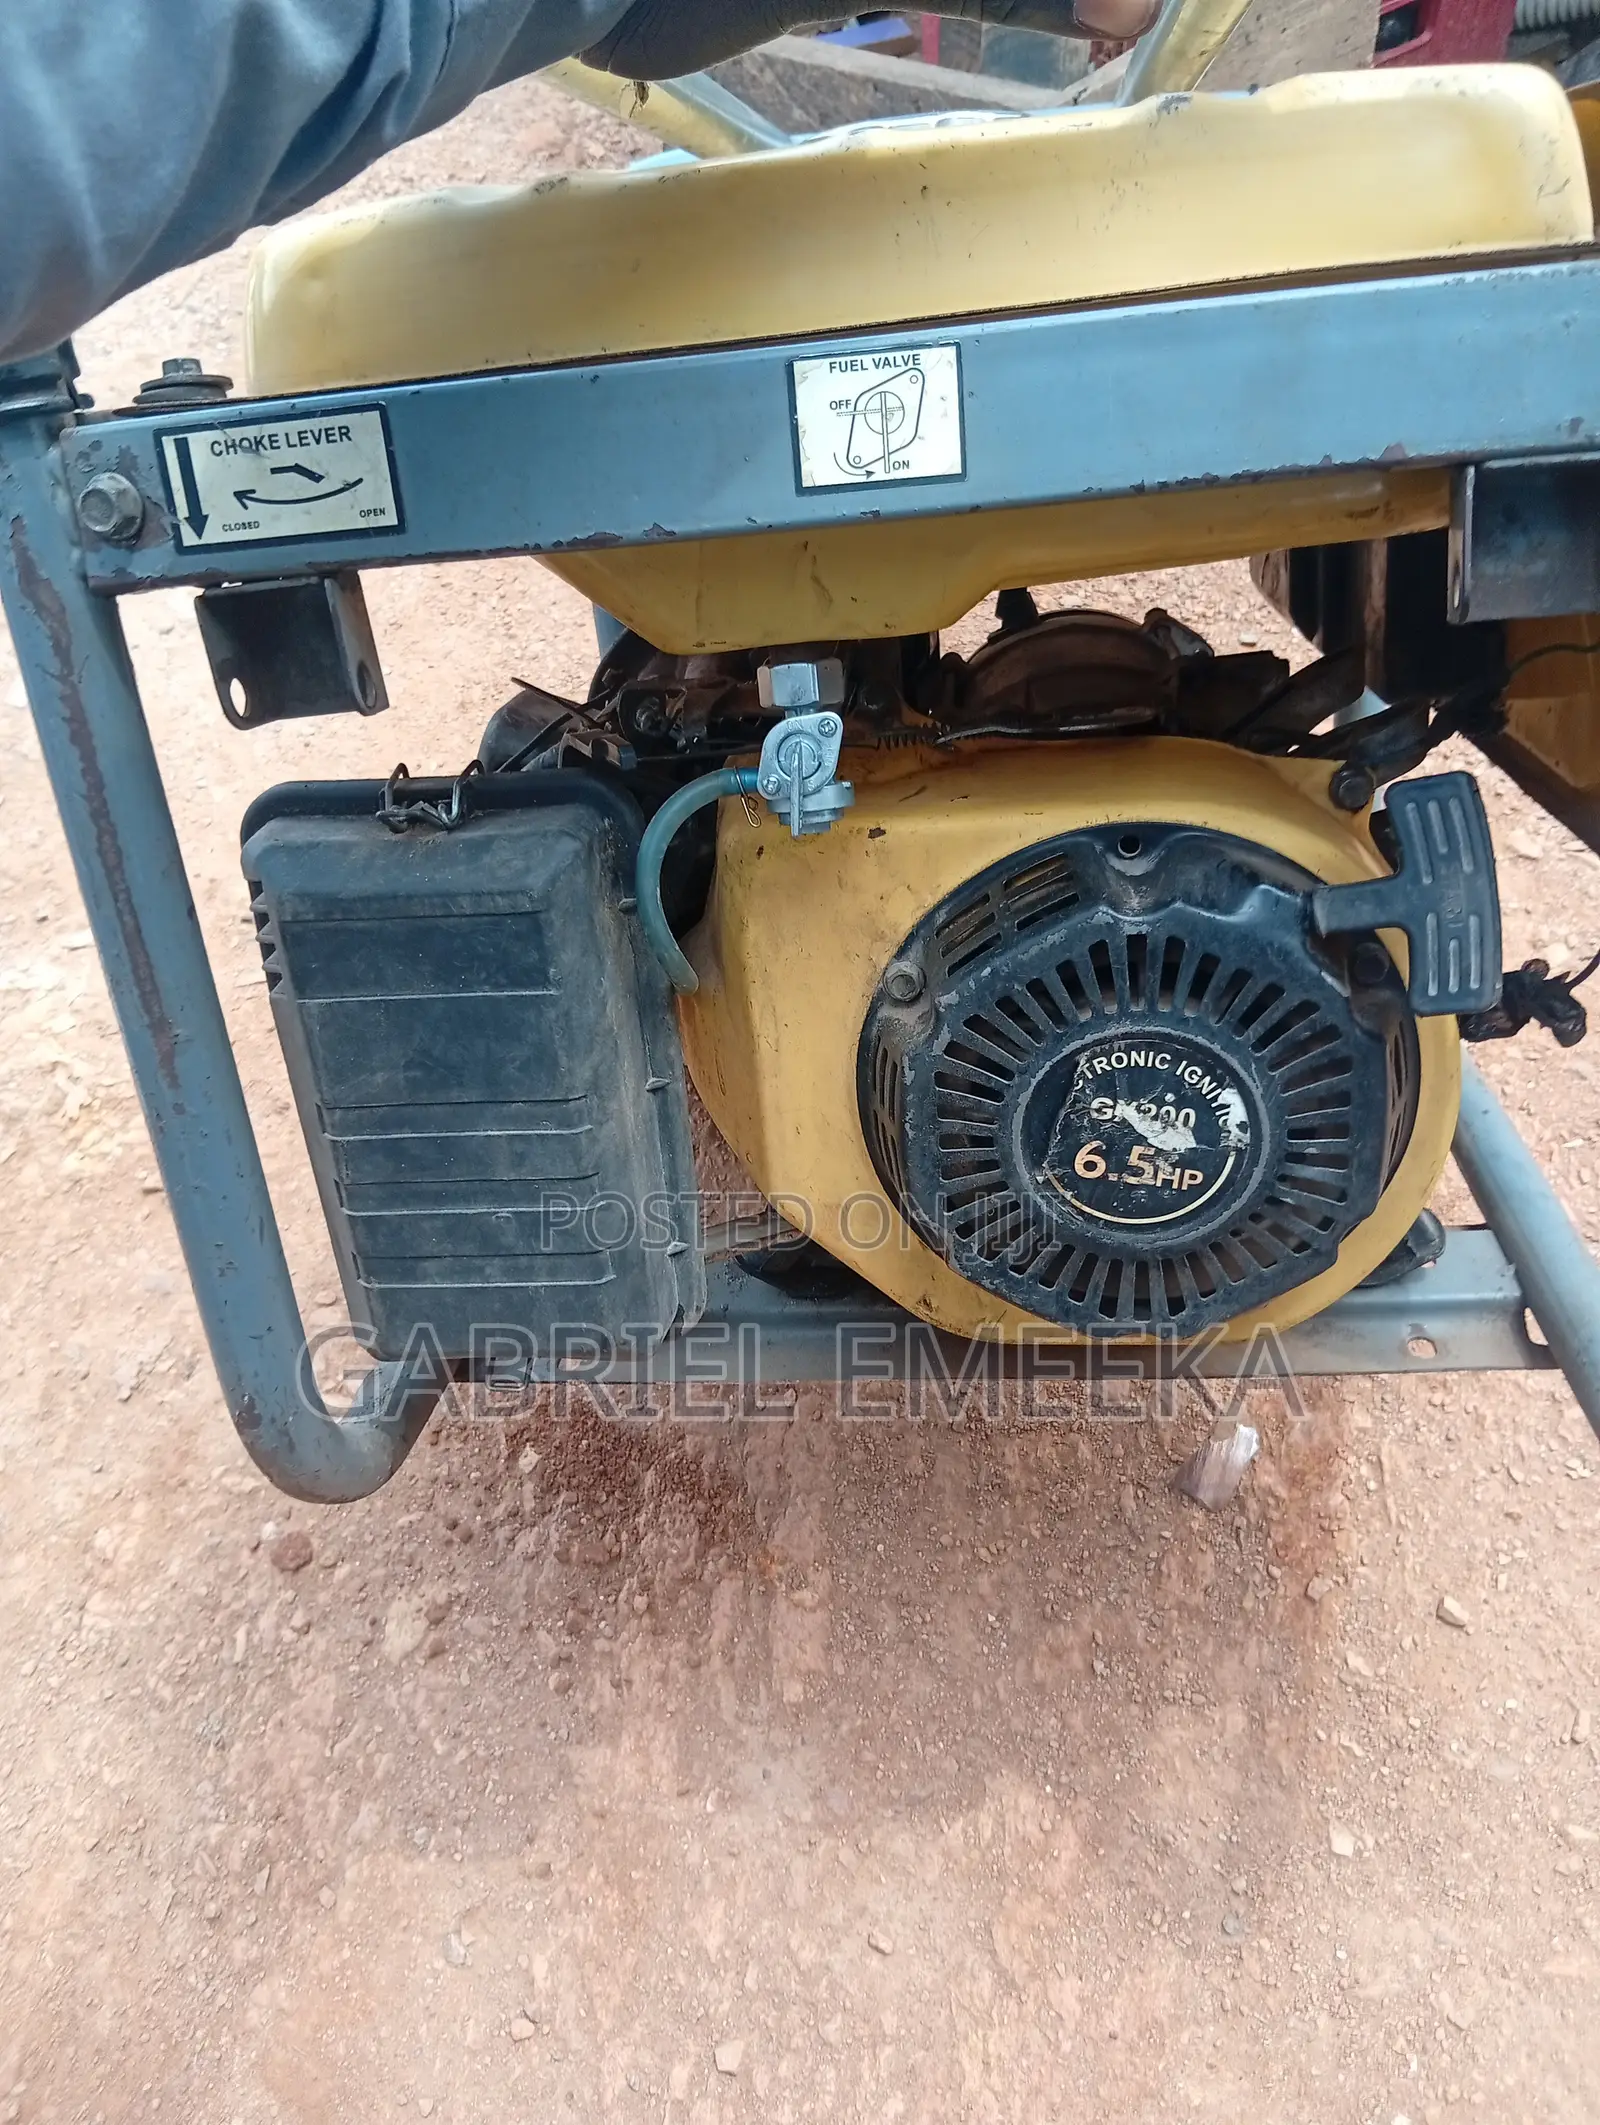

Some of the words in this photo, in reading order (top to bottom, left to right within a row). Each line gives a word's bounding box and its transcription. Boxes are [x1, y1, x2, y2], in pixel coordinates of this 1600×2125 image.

[829, 359, 868, 374] FUEL
[872, 353, 921, 370] VALVE
[829, 399, 852, 411] OFF
[210, 433, 281, 457] CHOKE
[285, 425, 352, 449] LEVER
[892, 460, 910, 471] ON
[359, 507, 386, 519] OPEN
[222, 520, 260, 533] CLOSED
